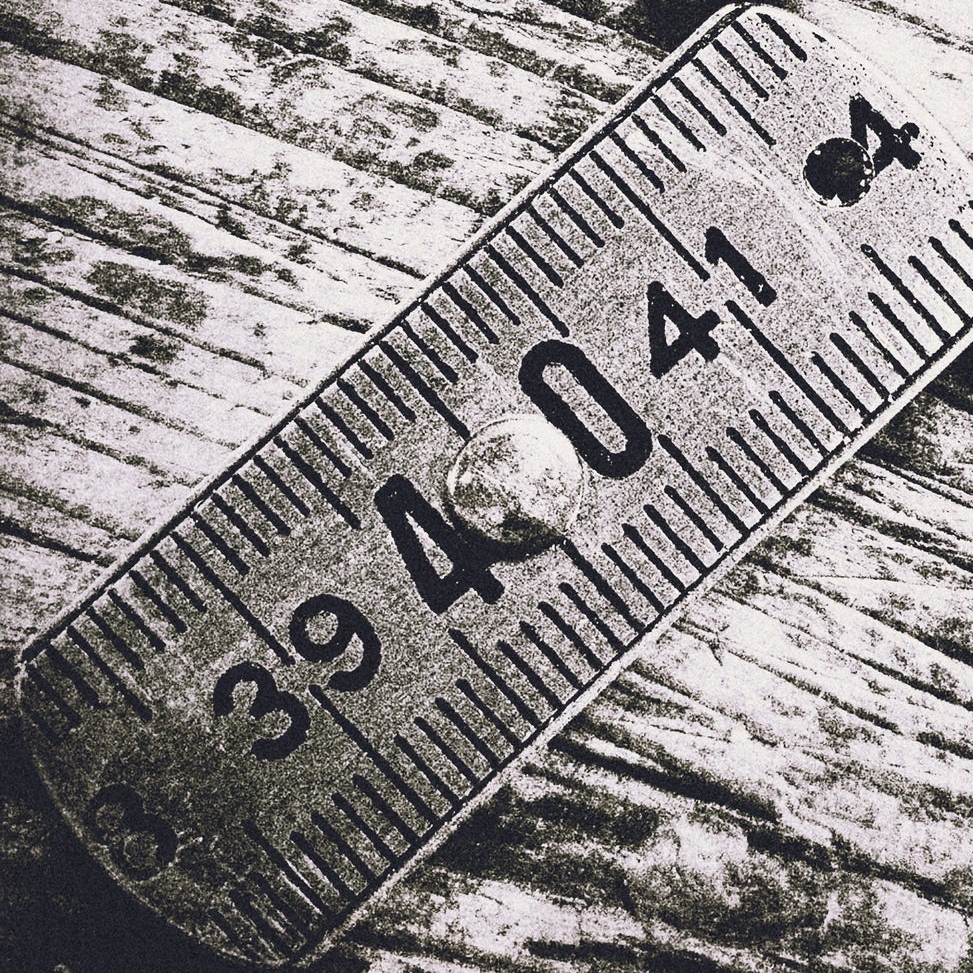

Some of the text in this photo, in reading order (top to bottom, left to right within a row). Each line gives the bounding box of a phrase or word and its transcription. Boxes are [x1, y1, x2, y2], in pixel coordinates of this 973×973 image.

[849, 92, 922, 176] 4
[646, 226, 777, 380] 41
[373, 339, 653, 614] 40
[212, 593, 382, 761] 39
